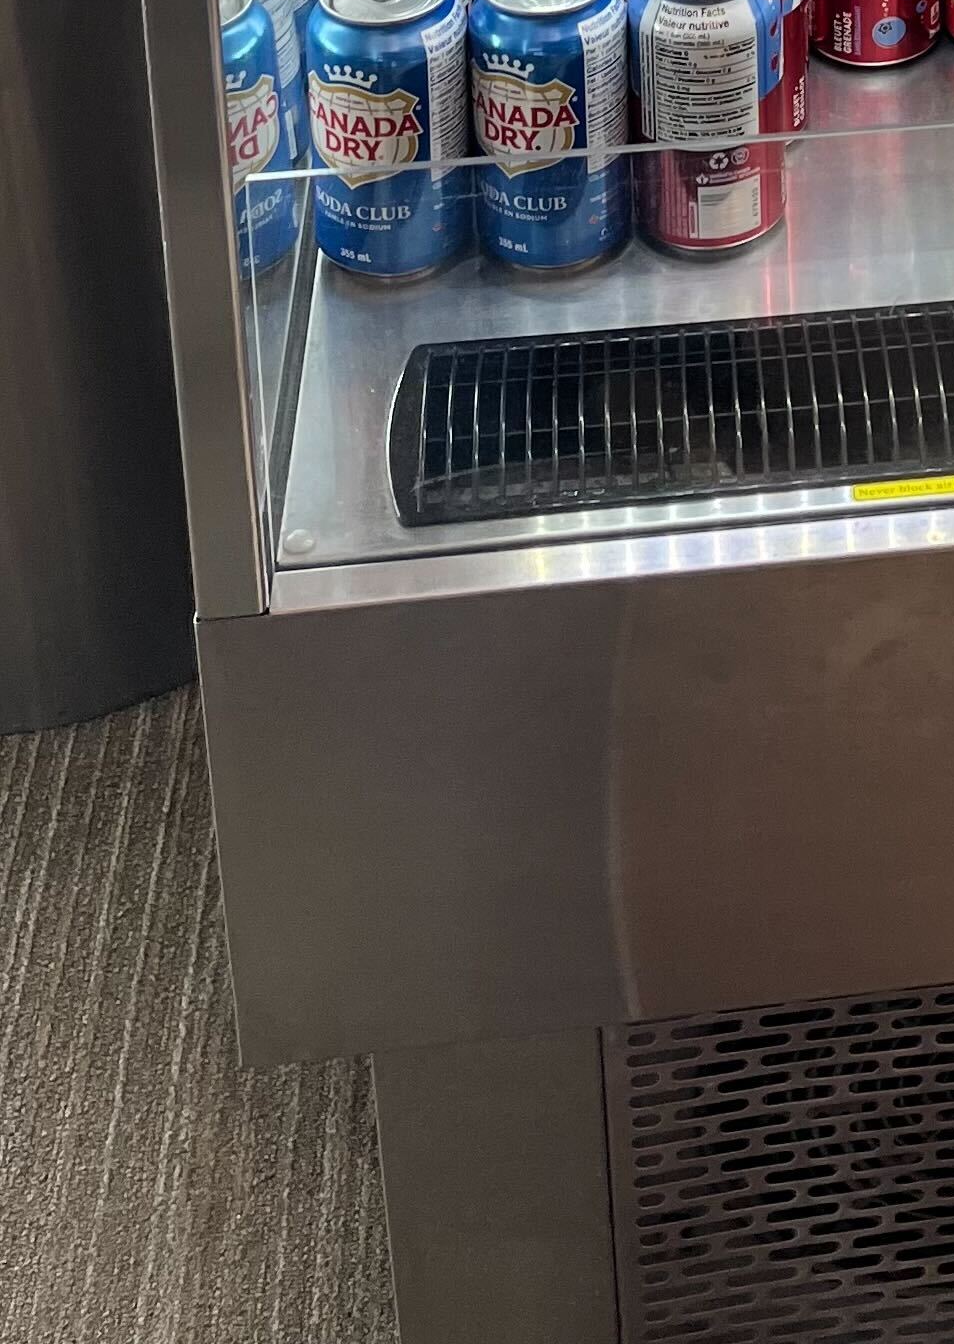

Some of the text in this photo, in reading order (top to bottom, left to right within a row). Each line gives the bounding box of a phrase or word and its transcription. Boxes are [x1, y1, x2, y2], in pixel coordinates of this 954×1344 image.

[661, 3, 727, 18] Nutrition Facts
[658, 16, 730, 31] Valeur nutritive
[833, 20, 842, 52] BLEUET
[842, 12, 853, 54] GRENADE
[475, 94, 579, 128] ANADA
[484, 121, 541, 151] DRY
[325, 128, 383, 162] DRY
[316, 185, 412, 221] SODA CLUB
[513, 196, 568, 212] CLUB
[515, 212, 549, 222] SODIUM
[358, 222, 391, 231] SODIUM
[514, 243, 529, 254] mL
[357, 252, 372, 263] mL
[857, 485, 897, 498] Never
[899, 482, 933, 495] block
[935, 481, 953, 491] air
